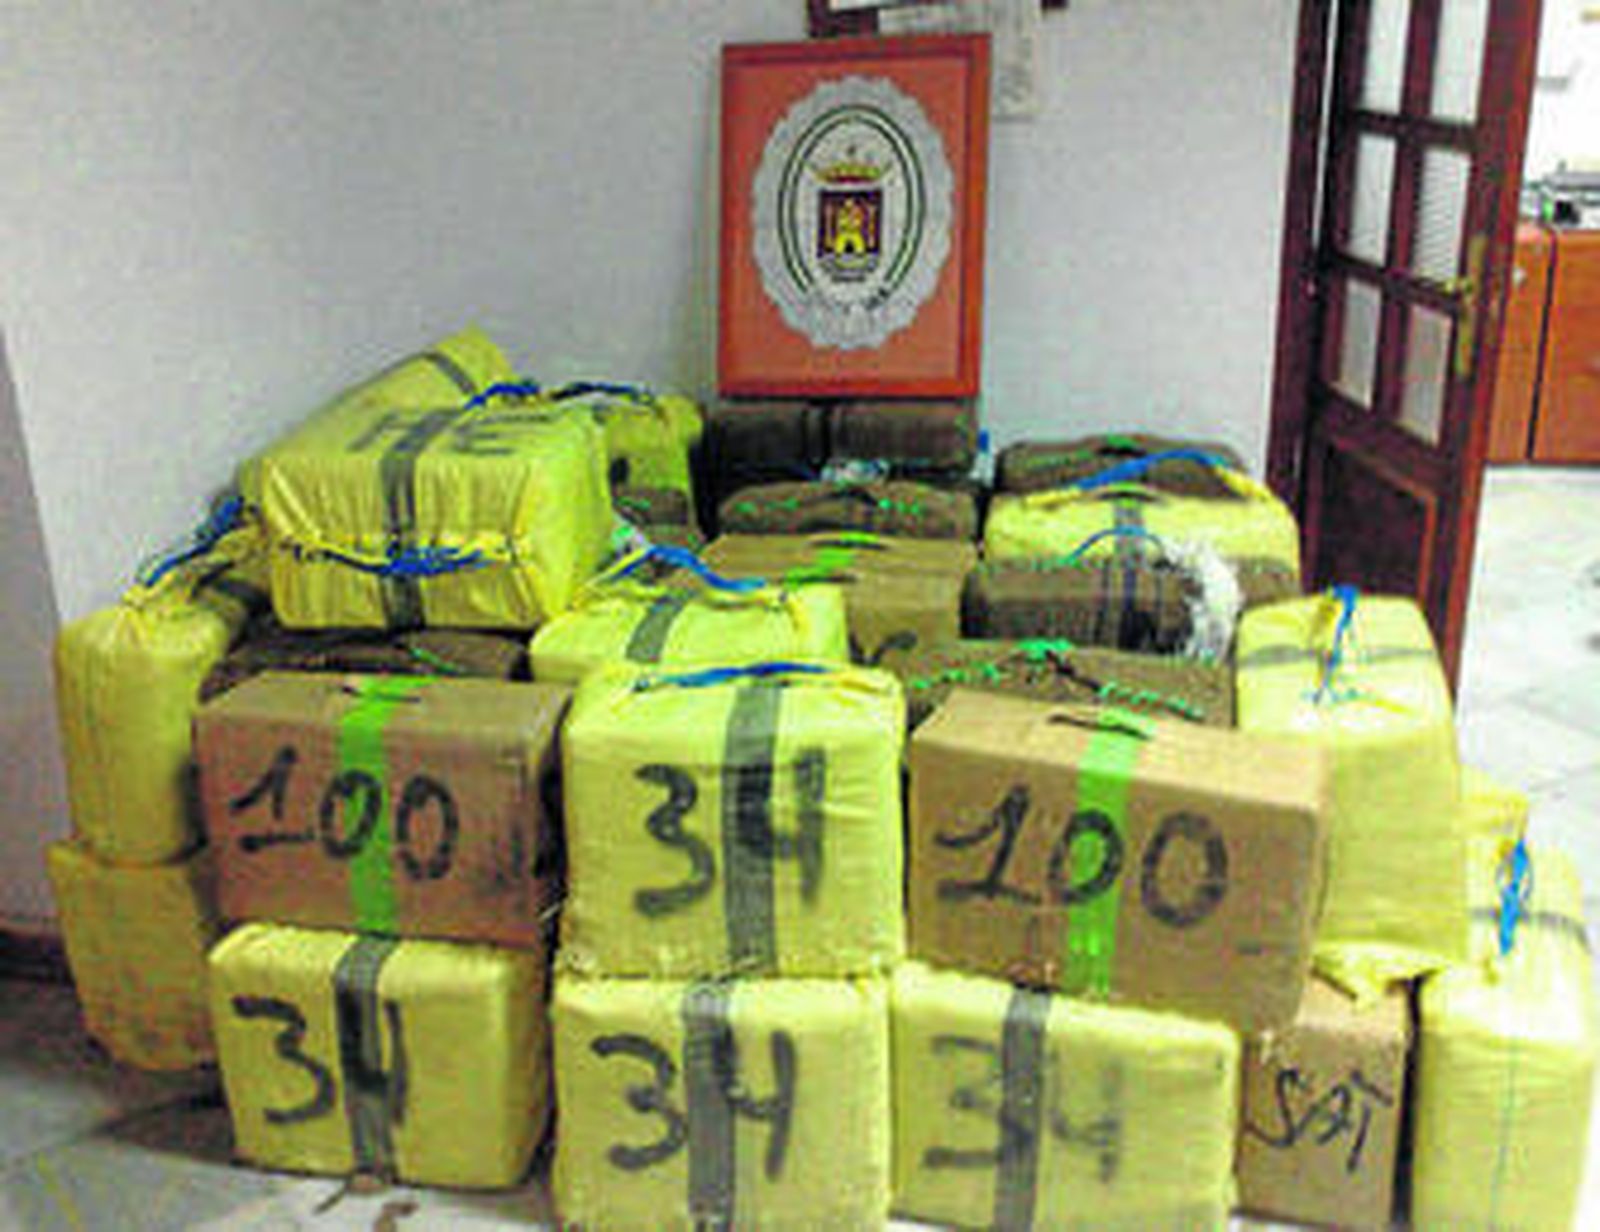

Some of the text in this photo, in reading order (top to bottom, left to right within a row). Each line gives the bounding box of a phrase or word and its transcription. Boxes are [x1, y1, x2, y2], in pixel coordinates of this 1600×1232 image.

[232, 746, 459, 880] 100
[633, 748, 825, 914] 34
[934, 784, 1229, 926] 100
[231, 995, 409, 1124] 34
[590, 1031, 795, 1181] 34
[922, 1034, 1123, 1183] 34
